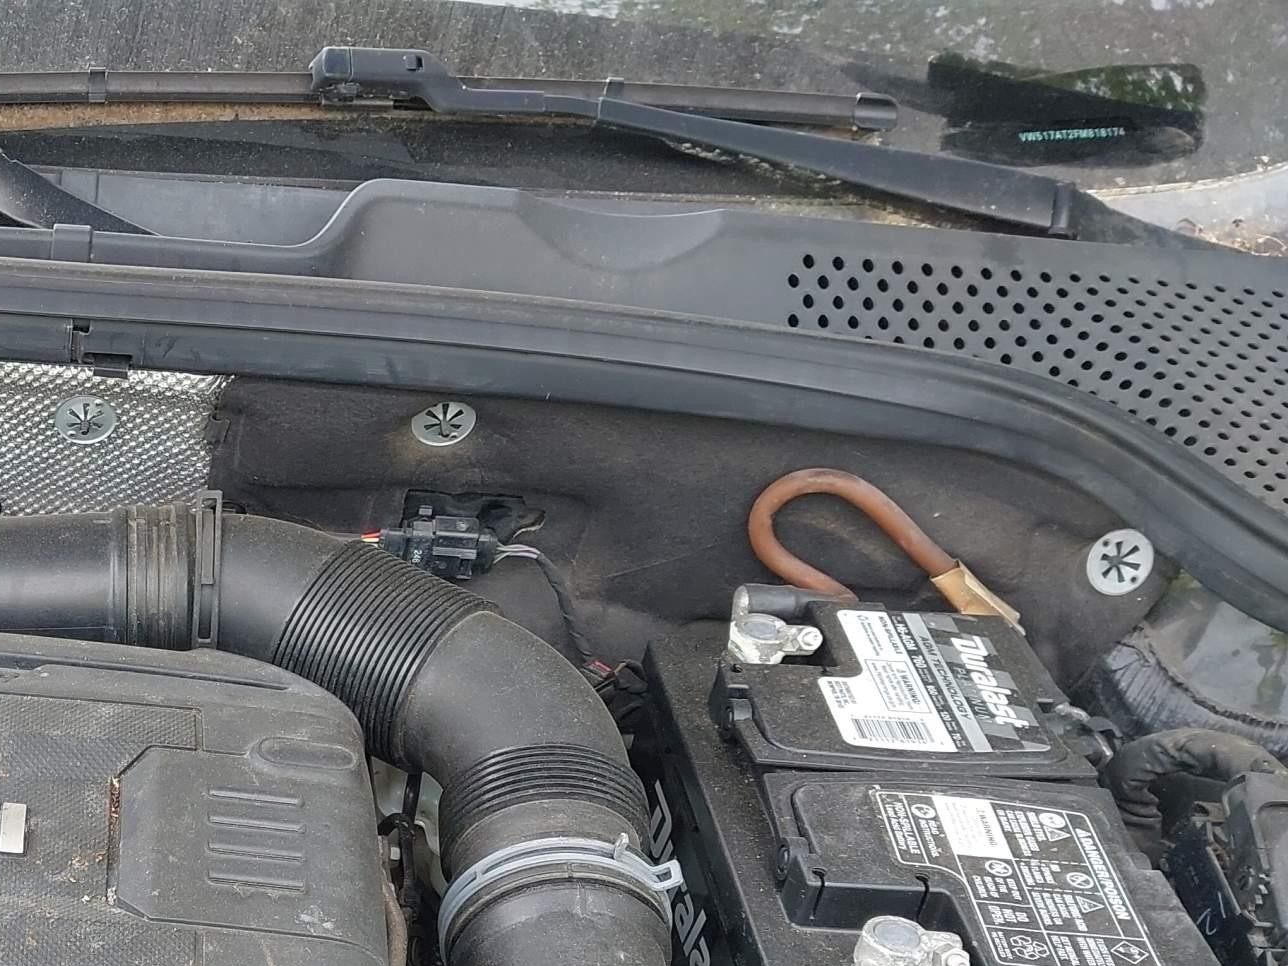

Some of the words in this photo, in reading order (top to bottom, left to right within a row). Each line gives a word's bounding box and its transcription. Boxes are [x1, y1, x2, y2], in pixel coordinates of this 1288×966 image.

[918, 636, 937, 655] AGM
[930, 658, 972, 720] TECHNOLOGY
[949, 636, 1030, 728] Duralast
[892, 801, 921, 854] NON-SPILLABLE
[1001, 908, 1017, 923] NOT
[1078, 837, 1131, 920] DANGER/POISON
